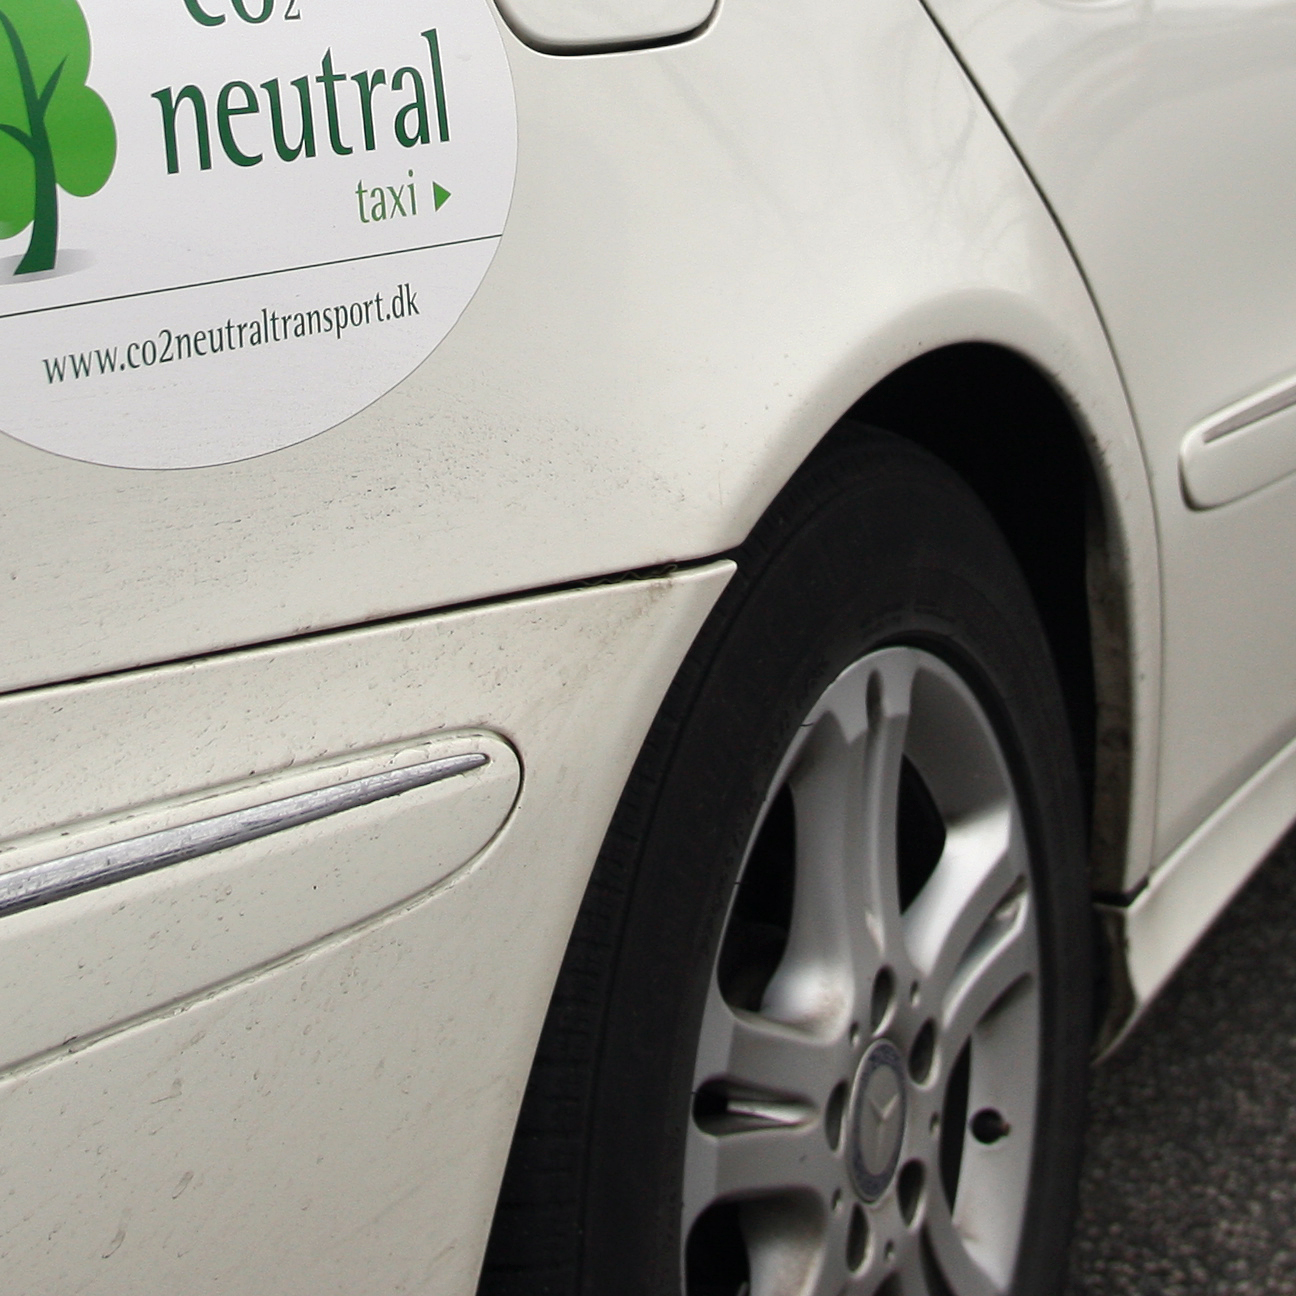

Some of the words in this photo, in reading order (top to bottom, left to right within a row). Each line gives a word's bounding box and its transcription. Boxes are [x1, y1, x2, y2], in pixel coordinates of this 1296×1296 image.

[151, 28, 450, 175] neutral
[355, 169, 417, 223] taxi
[42, 283, 421, 384] www.co2neutraltransport.dk
